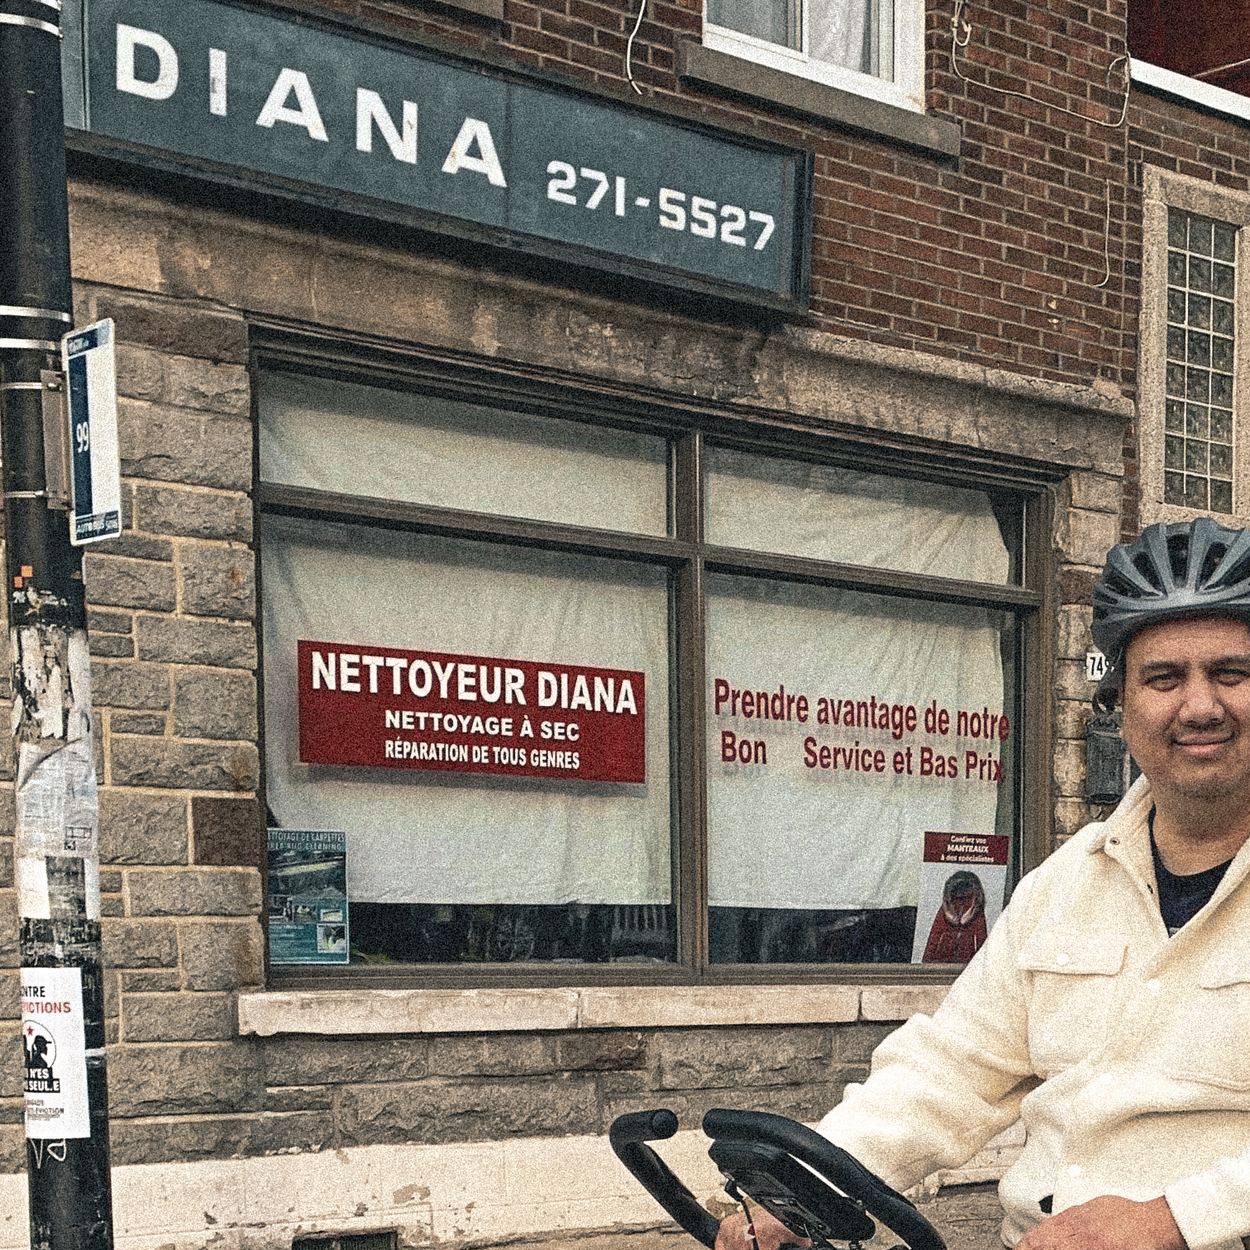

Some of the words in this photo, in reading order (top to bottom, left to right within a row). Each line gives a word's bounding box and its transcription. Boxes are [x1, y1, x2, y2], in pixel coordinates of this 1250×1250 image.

[115, 24, 507, 188] DIANA
[545, 161, 776, 251] 271-5527
[76, 421, 89, 453] 99
[311, 651, 525, 706] NETTOYEUR
[537, 671, 638, 715] DIANA
[385, 710, 513, 737] NETTOYAGE
[519, 715, 534, 738] À
[541, 721, 580, 742] SEC
[714, 678, 810, 723] Prendre
[816, 696, 917, 740] avantage
[924, 699, 950, 736] de
[957, 707, 1010, 741] notre
[385, 736, 468, 763] RÉPARATION
[473, 745, 489, 764] DE
[493, 746, 526, 766] TOUS
[530, 749, 580, 769] GENRES
[721, 731, 767, 765] Bon
[804, 737, 886, 773] Service
[892, 747, 913, 775] et
[920, 747, 958, 779] Bas
[965, 750, 1005, 783] Prix
[947, 844, 989, 853] MANTEAUX
